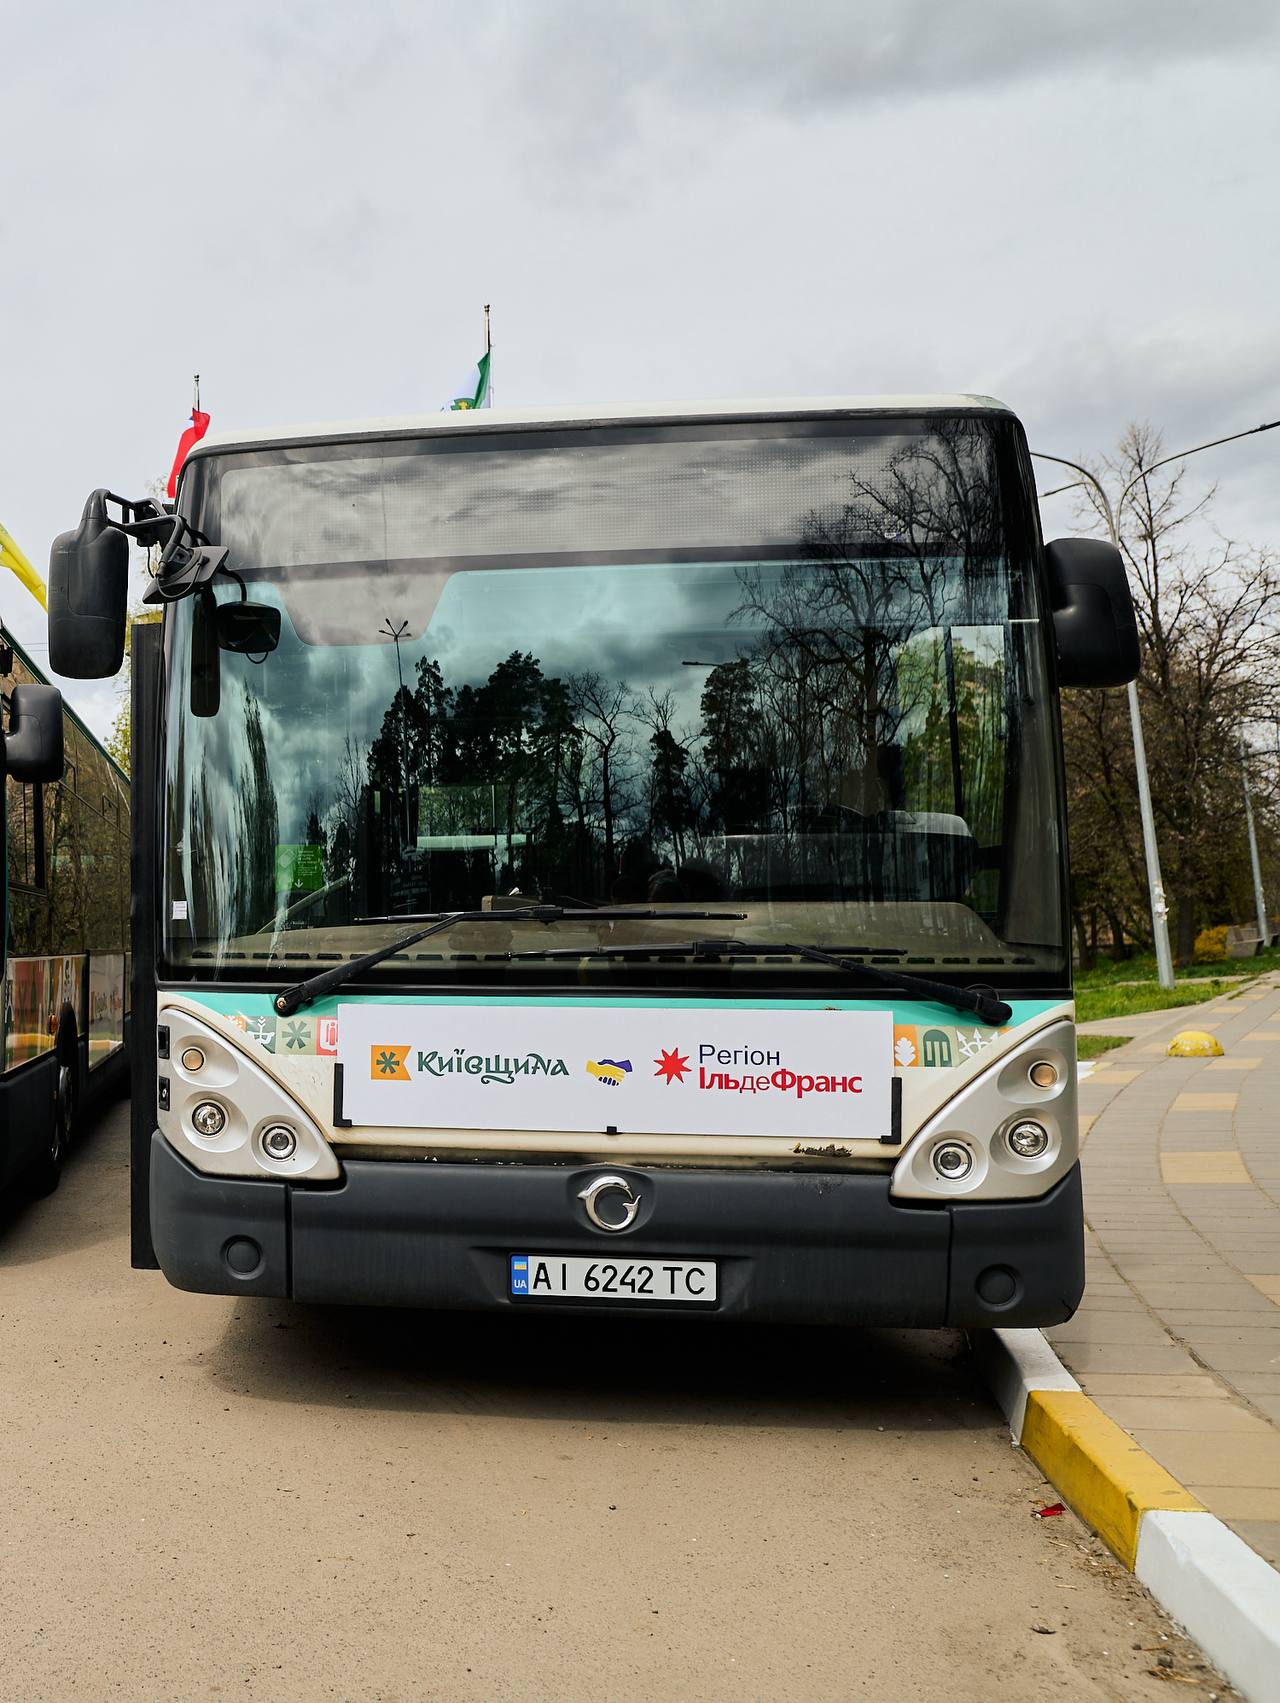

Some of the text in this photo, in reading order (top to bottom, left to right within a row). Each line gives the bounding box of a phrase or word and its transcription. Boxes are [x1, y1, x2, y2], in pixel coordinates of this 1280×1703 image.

[417, 1048, 570, 1085] Київщина
[698, 1044, 781, 1066] Регіон
[698, 1066, 864, 1098] ІльдеФранс
[514, 1279, 528, 1289] UA
[533, 1262, 706, 1295] AI 6242 TC
